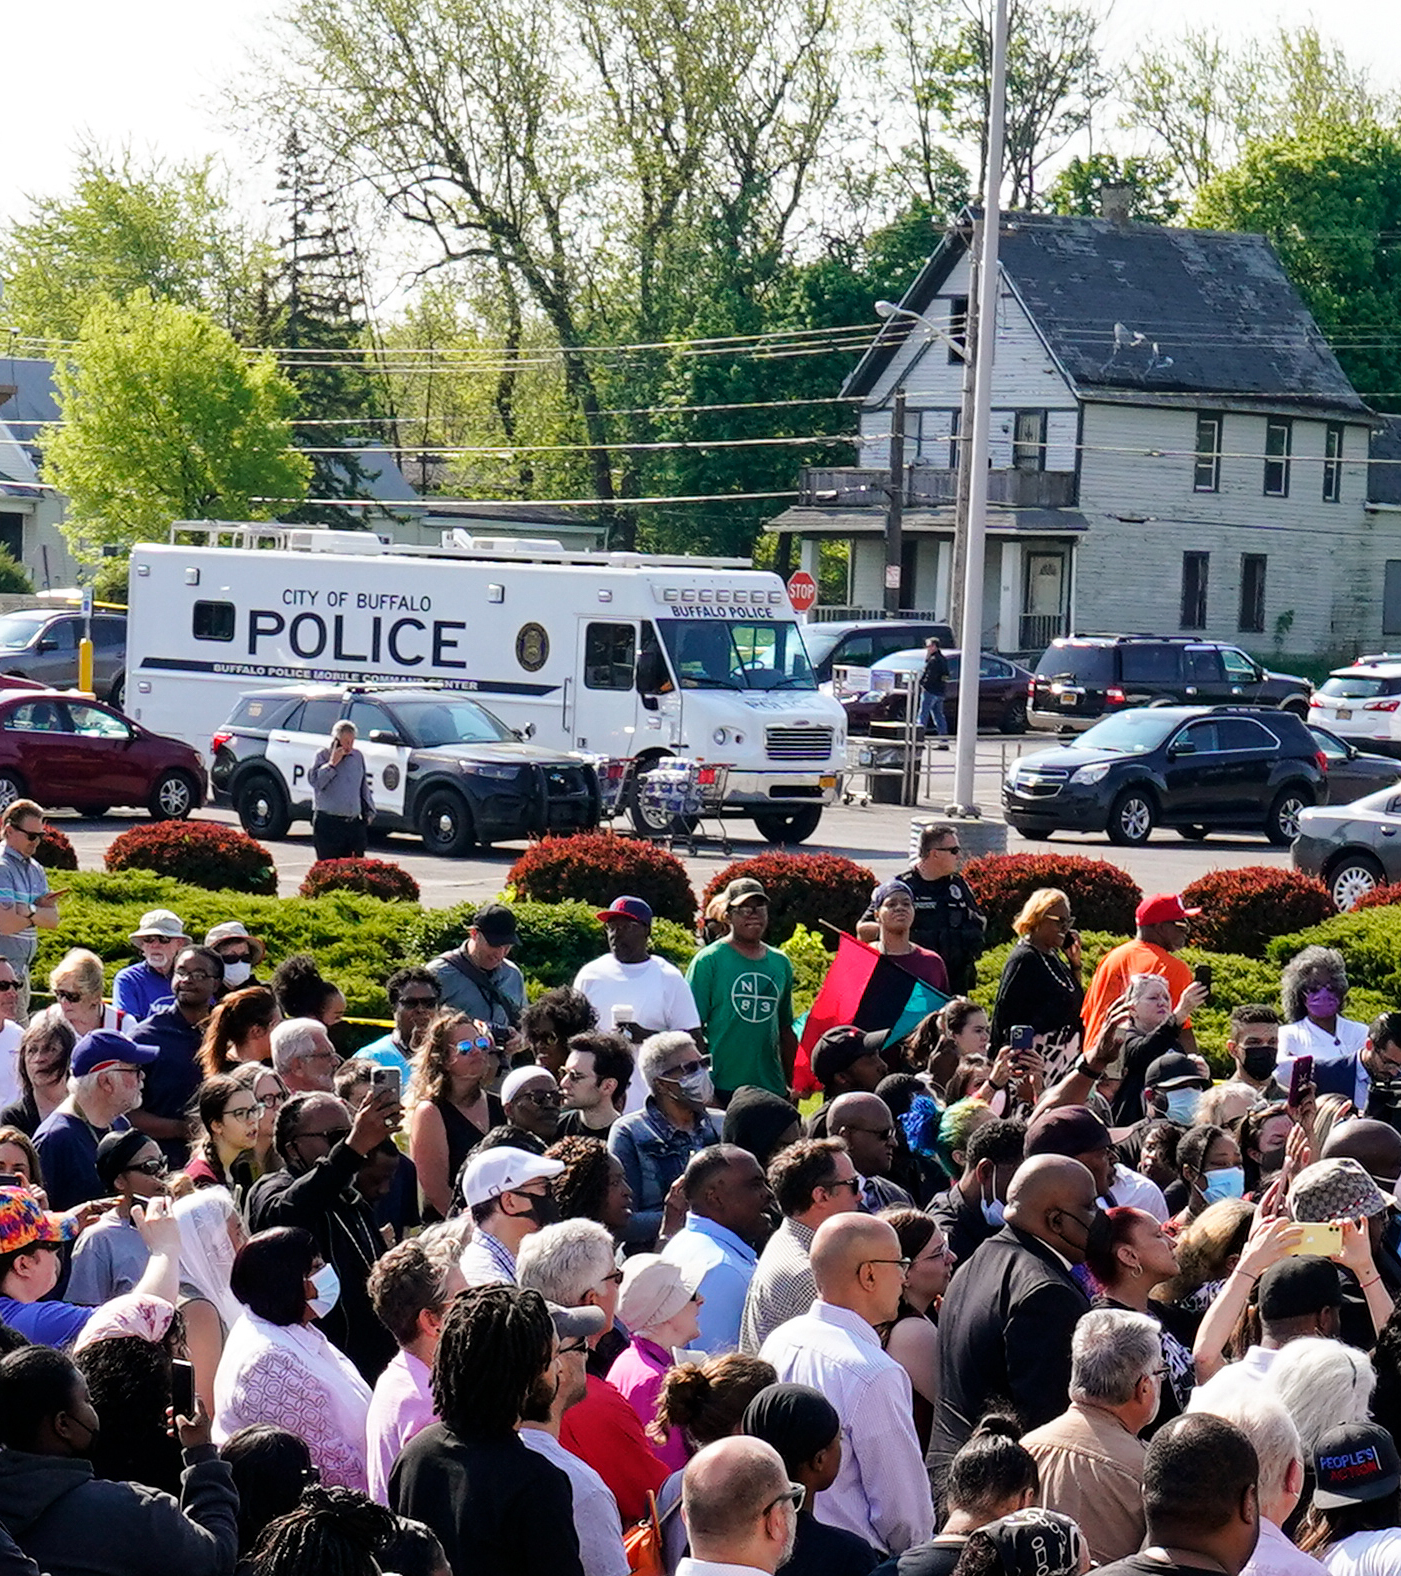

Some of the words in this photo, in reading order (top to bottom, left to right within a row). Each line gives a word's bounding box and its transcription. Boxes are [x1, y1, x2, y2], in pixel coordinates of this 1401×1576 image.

[282, 588, 320, 606] CITY
[327, 591, 349, 608] OF
[356, 591, 432, 612] BUFFALO
[789, 583, 815, 600] STOP
[671, 605, 727, 618] BUFFALO
[729, 606, 774, 619] POLICE
[248, 609, 467, 669] POLICE
[213, 663, 266, 676] BUFFALO
[268, 666, 311, 679] POLICE
[313, 669, 360, 682] MOBILE
[740, 980, 753, 993] N
[740, 999, 751, 1011] 8
[760, 1001, 771, 1013] 3
[1319, 1447, 1375, 1471] PEOPLE'S
[1329, 1460, 1378, 1481] ACTION
